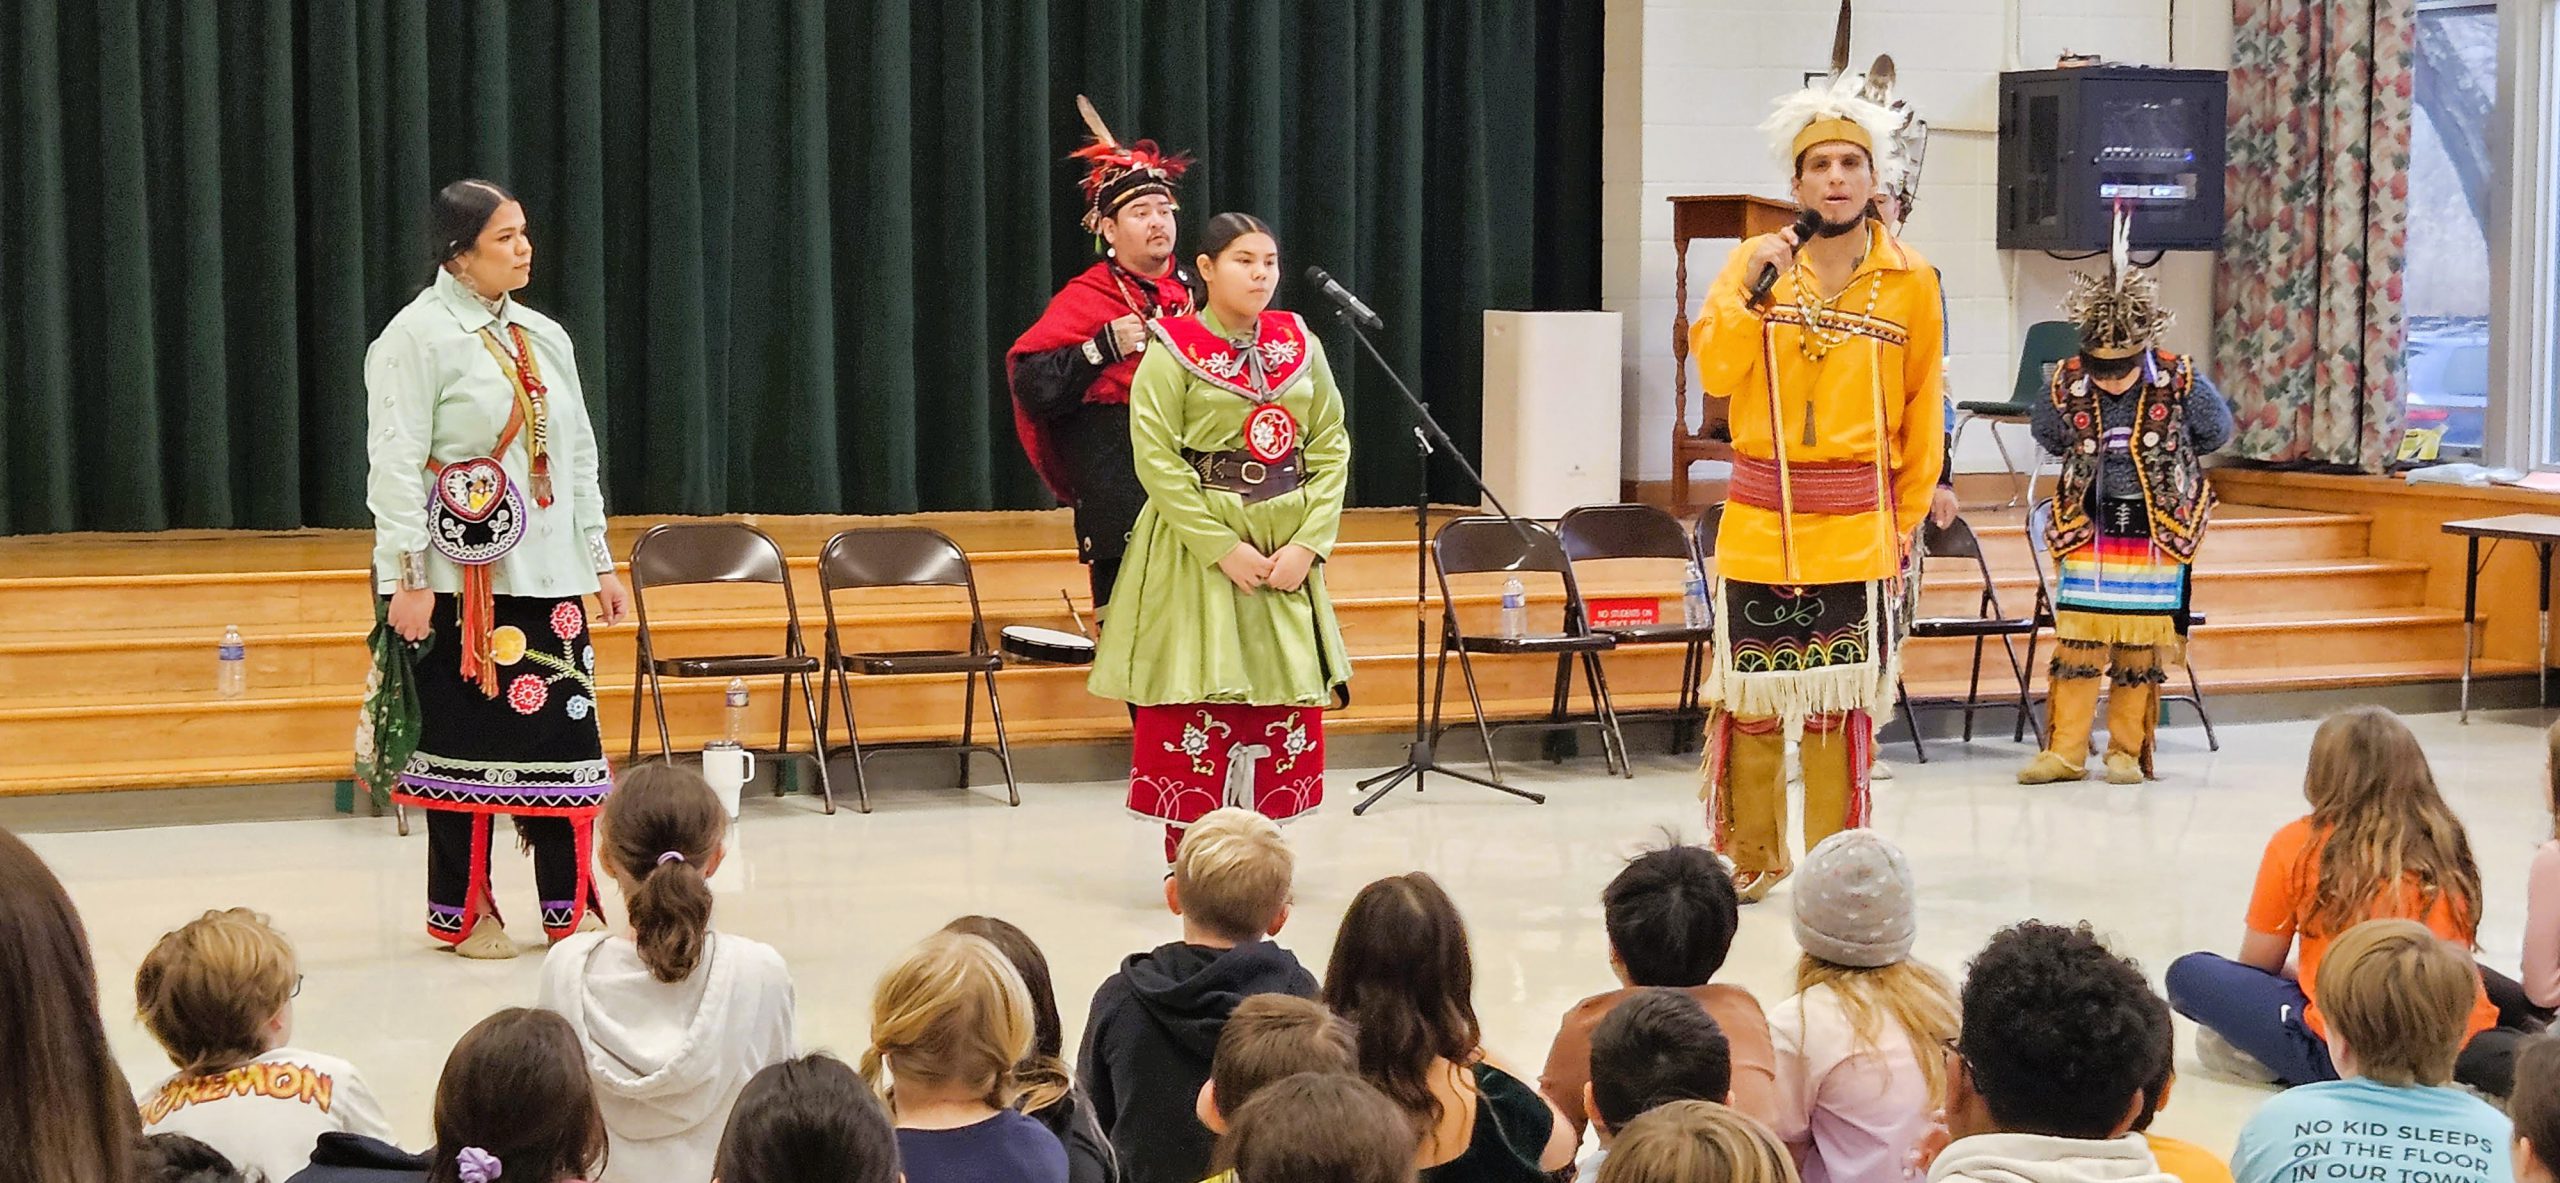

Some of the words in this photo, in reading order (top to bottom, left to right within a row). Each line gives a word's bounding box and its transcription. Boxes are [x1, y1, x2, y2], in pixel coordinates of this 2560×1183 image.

[1597, 610, 1609, 618] NO
[2294, 1119, 2333, 1138] NO
[2343, 1120, 2388, 1138] KID
[2397, 1125, 2493, 1154] SLEEPS
[2294, 1141, 2331, 1159] ON
[2342, 1141, 2393, 1159] THE
[2403, 1147, 2489, 1175] FLOOR
[2292, 1164, 2317, 1183] IN
[2327, 1163, 2387, 1182] OUR
